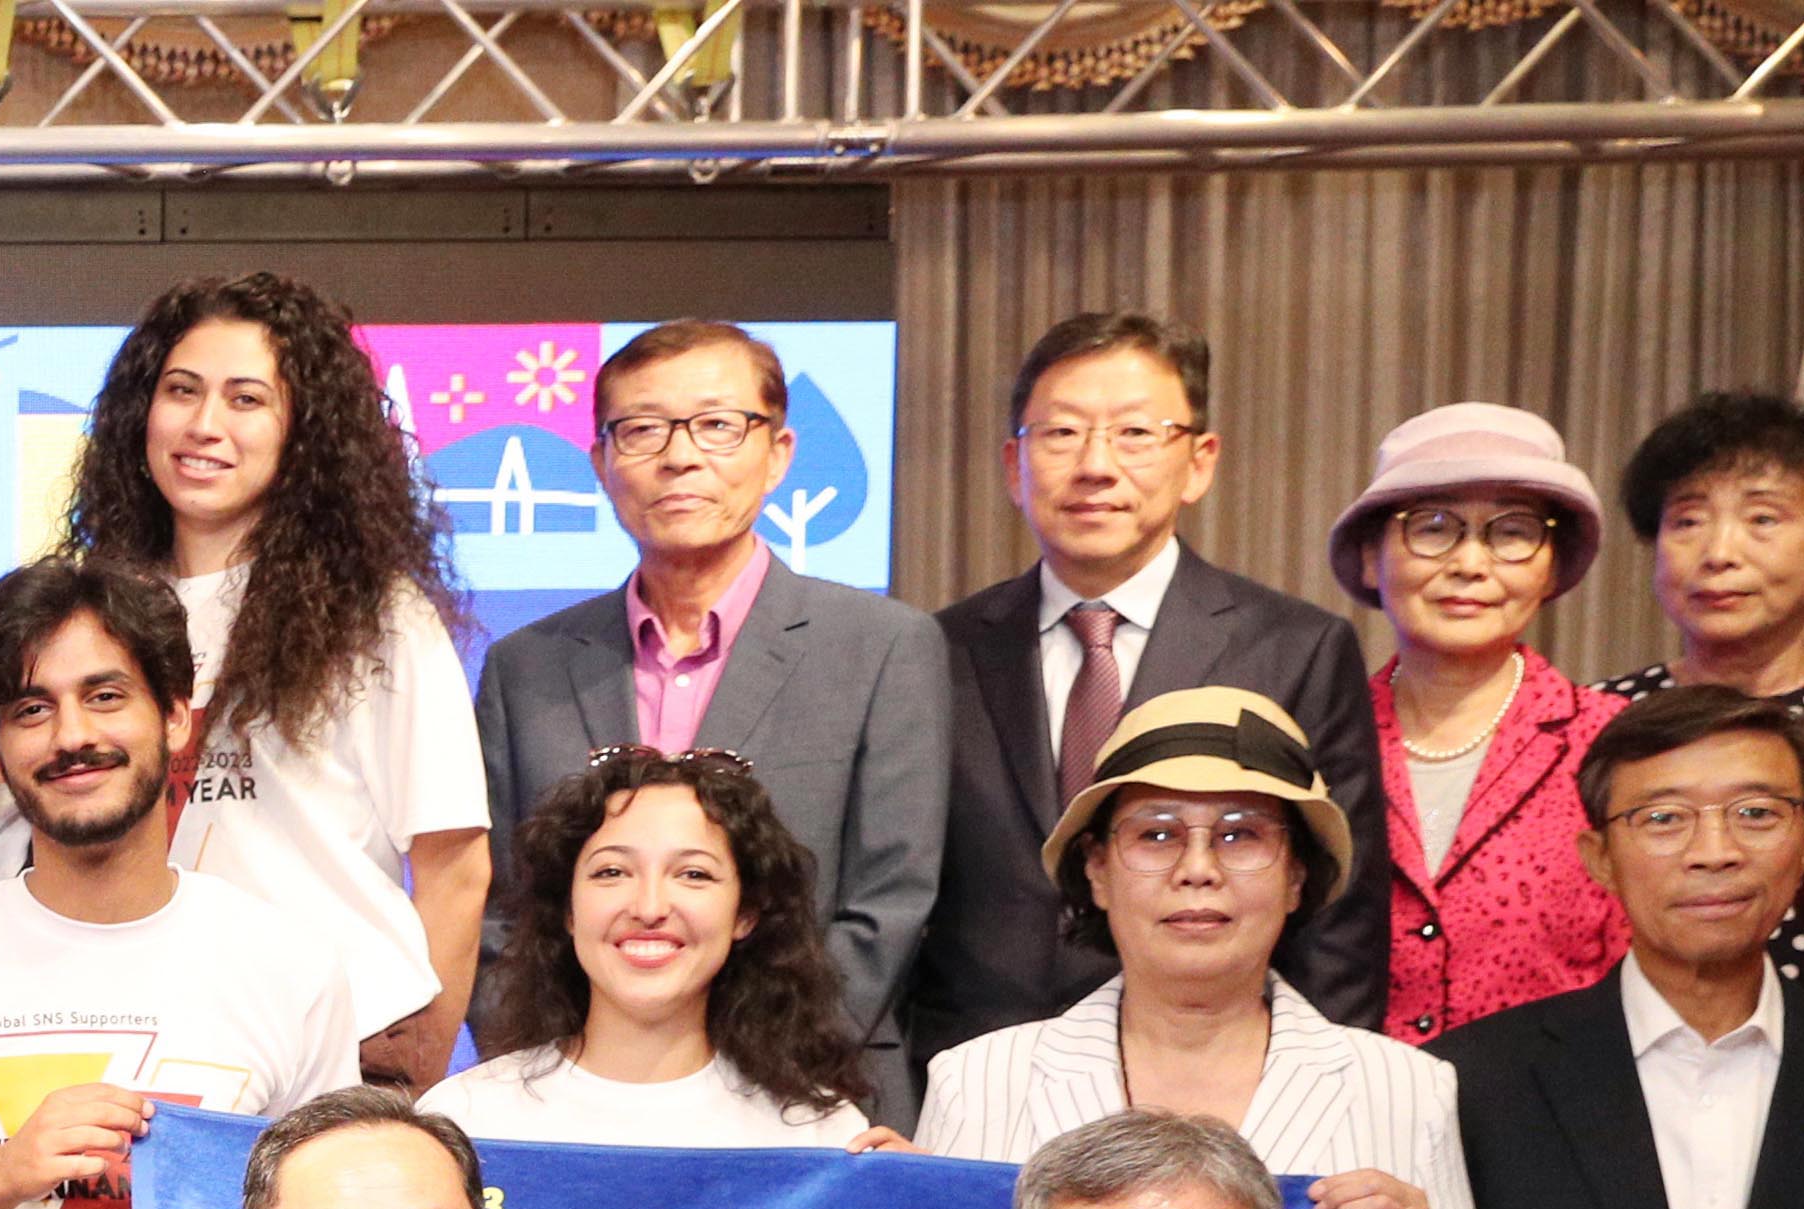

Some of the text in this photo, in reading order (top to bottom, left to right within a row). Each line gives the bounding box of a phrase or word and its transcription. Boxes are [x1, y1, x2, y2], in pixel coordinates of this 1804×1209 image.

[189, 778, 257, 804] YEAR
[33, 1012, 63, 1026] SNS
[70, 1011, 158, 1027] Supporters
